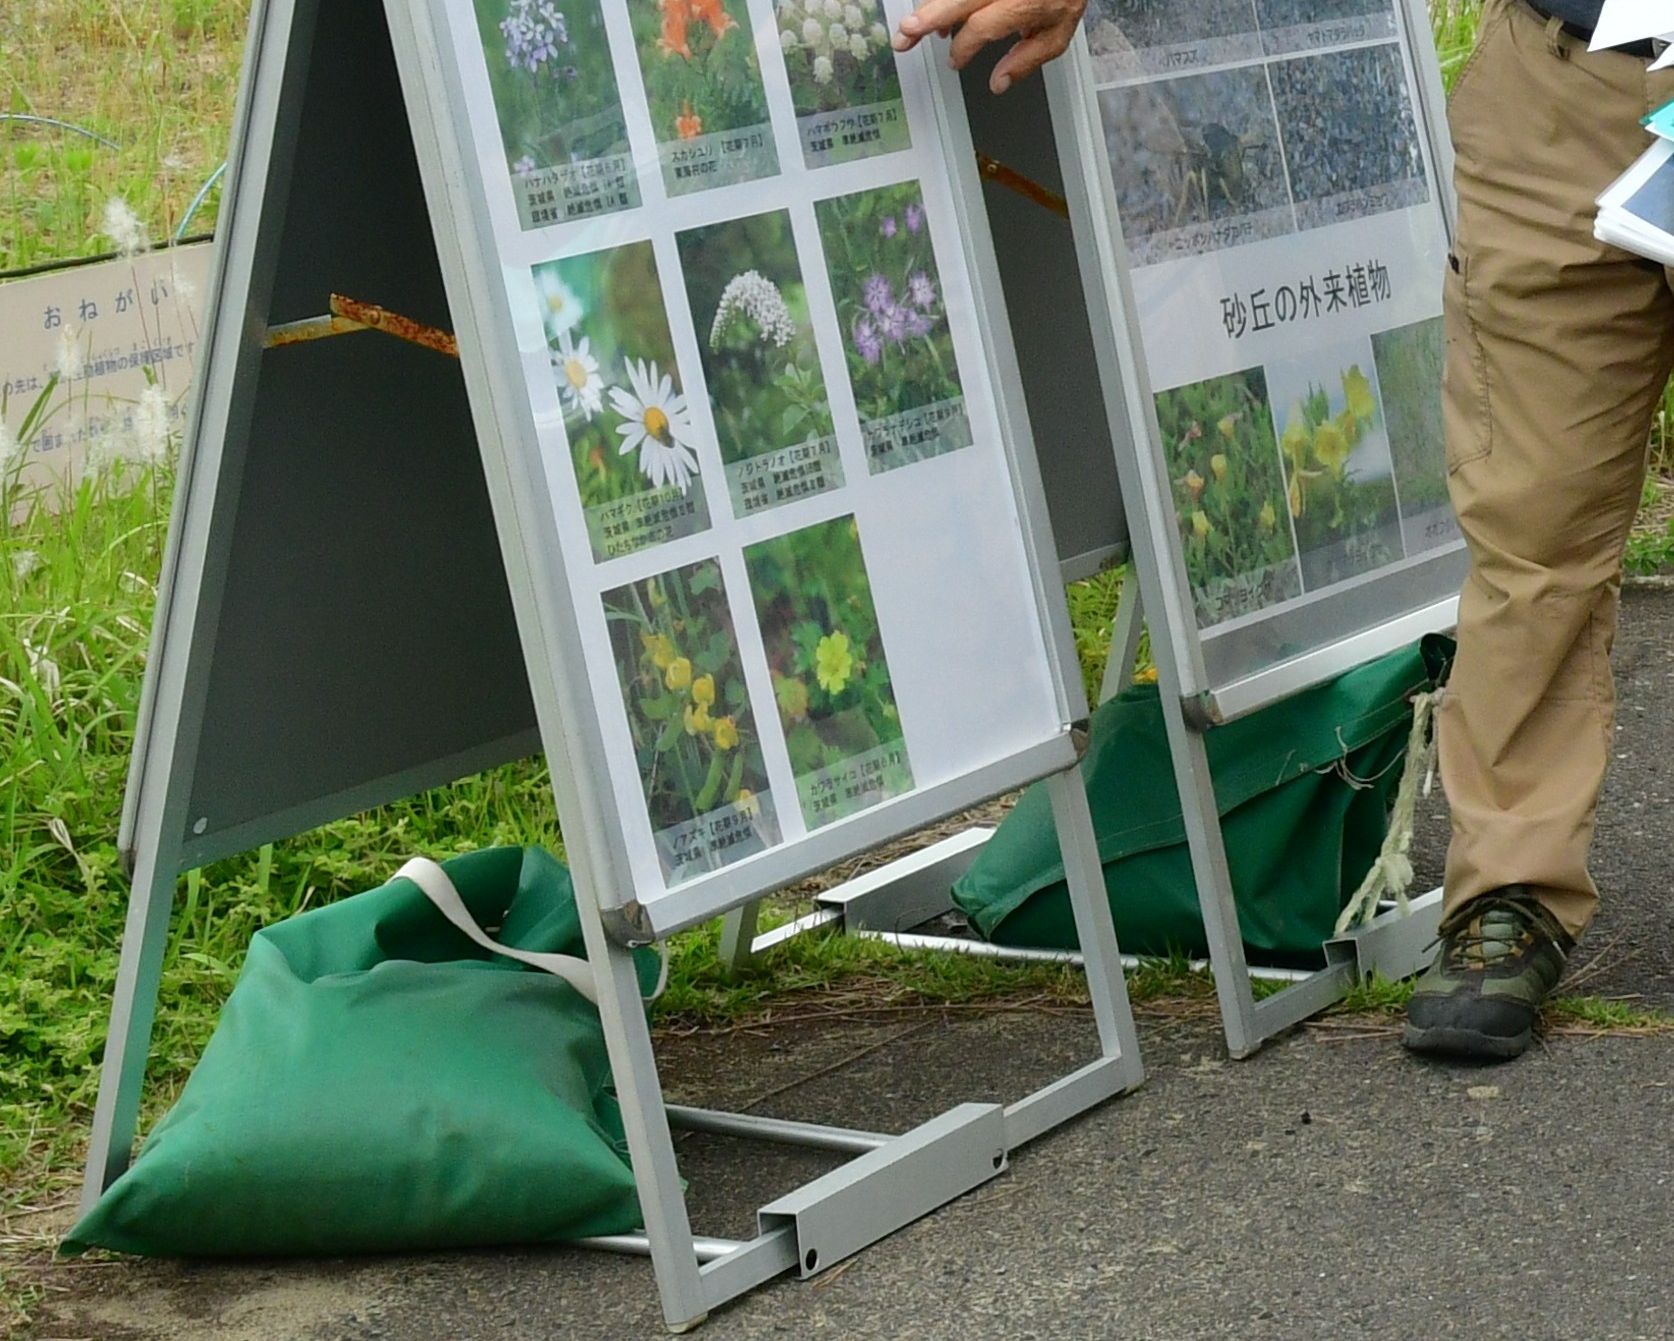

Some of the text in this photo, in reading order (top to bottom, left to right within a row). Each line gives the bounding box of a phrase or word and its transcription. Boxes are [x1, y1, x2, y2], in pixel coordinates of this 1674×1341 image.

[43, 285, 168, 330] おねがい
[1219, 259, 1391, 339] 砂丘の外来植物
